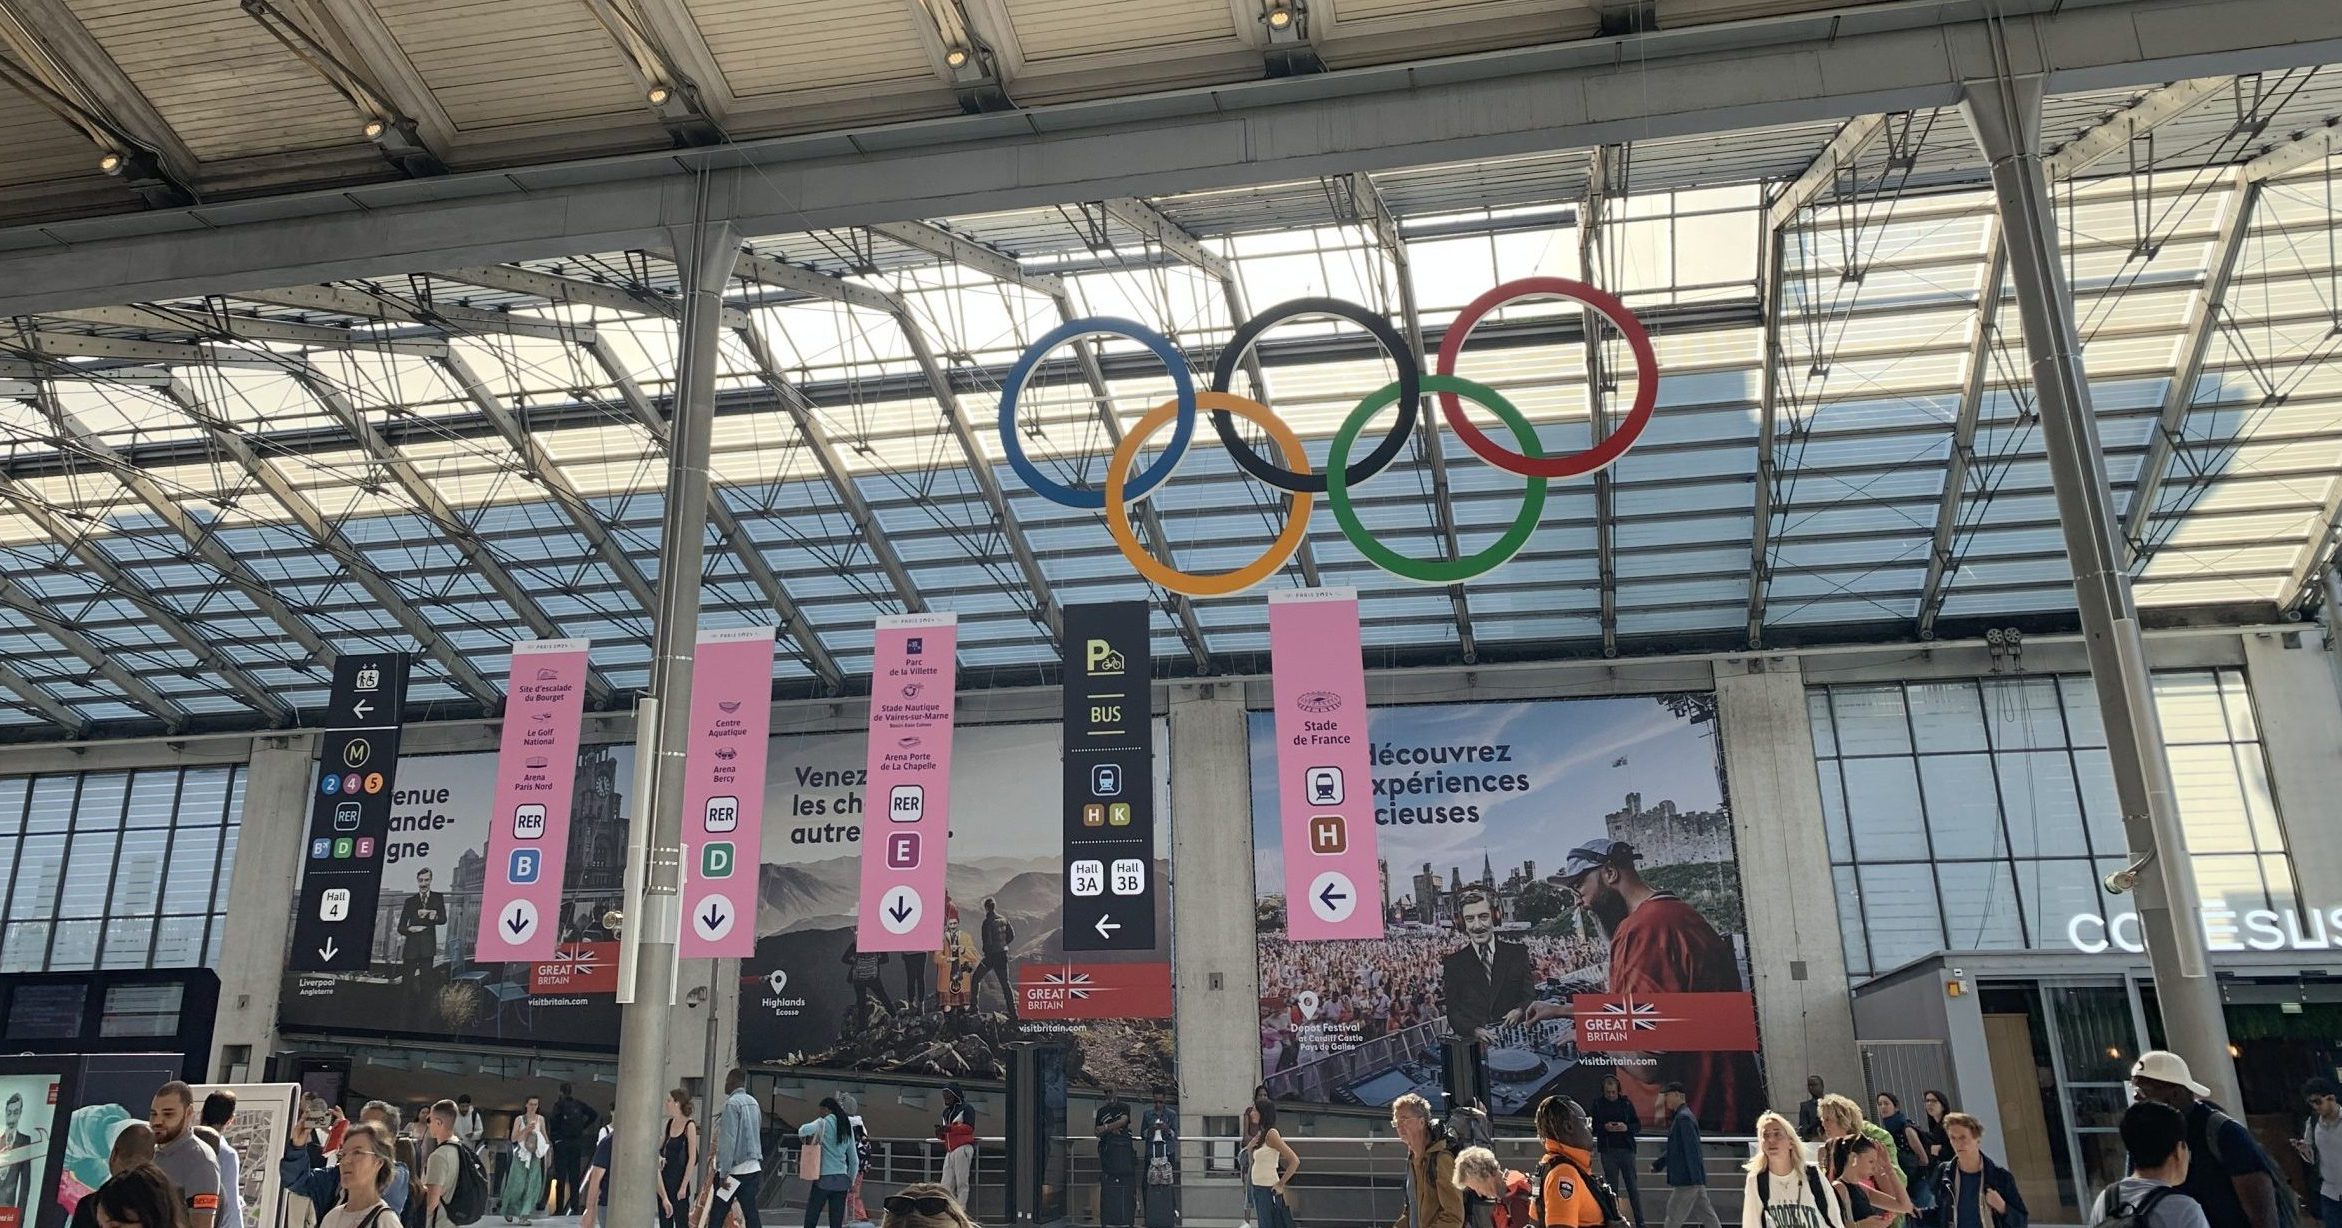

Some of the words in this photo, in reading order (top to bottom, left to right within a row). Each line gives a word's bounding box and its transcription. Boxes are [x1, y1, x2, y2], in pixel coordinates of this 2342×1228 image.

[901, 668, 908, 676] la
[910, 667, 938, 675] Villette
[519, 685, 534, 693] Site
[535, 684, 572, 693] d'escalade
[536, 694, 564, 703] Bourget
[881, 704, 903, 712] Stade
[905, 703, 940, 713] Nautique
[885, 712, 949, 721] Vaires-sur-Marne
[1091, 705, 1121, 723] BUS
[716, 719, 741, 728] Centre
[1304, 719, 1338, 732] Stade
[538, 728, 554, 737] Golf
[708, 727, 748, 738] Aquatique
[524, 737, 555, 746] National
[1293, 734, 1308, 746] de
[1312, 733, 1351, 745] France
[350, 745, 364, 761] M
[884, 753, 908, 761] Arena
[910, 752, 931, 761] Porte
[713, 765, 736, 774] Arena
[880, 762, 891, 771] de
[892, 762, 902, 771] La
[903, 761, 937, 772] Chapelle
[524, 774, 546, 782] Arena
[713, 774, 736, 784] Bercy
[795, 766, 868, 788] Venez
[327, 778, 335, 791] 2
[347, 777, 356, 790] 4
[370, 777, 378, 790] 5
[515, 783, 532, 791] Paris
[534, 782, 553, 790] Nord
[793, 794, 826, 816] les
[894, 796, 919, 811] RER
[338, 810, 358, 823] RER
[709, 807, 734, 822] RER
[1089, 809, 1100, 822] H
[1115, 808, 1126, 820] K
[518, 814, 542, 829] RER
[1318, 824, 1338, 846] H
[339, 842, 349, 854] D
[360, 842, 370, 854] E
[897, 840, 910, 861] E
[710, 850, 728, 871] D
[516, 857, 532, 876] B
[1077, 863, 1099, 874] Hall
[1117, 862, 1139, 874] Hall
[1077, 876, 1098, 892] 3A
[1117, 876, 1139, 891] 3B
[327, 892, 346, 902] Hall
[330, 904, 338, 918] 4
[538, 964, 572, 976] GREAT
[299, 978, 336, 989] Liverpool
[538, 975, 570, 985] BRITAIN
[300, 988, 334, 998] Angleterre
[1027, 988, 1065, 1000] GREAT
[528, 996, 588, 1007] visitbritain.com
[762, 998, 806, 1008] Highlands
[1028, 1000, 1064, 1010] BRITAIN
[776, 1008, 800, 1016] Ecosse
[1018, 1024, 1088, 1034] visitbritain.com
[1290, 1024, 1321, 1034] Depot
[1323, 1022, 1360, 1032] Festival
[1584, 1018, 1628, 1032] GREAT
[1308, 1034, 1337, 1042] Cardiff
[1338, 1034, 1364, 1042] Castle
[1587, 1031, 1628, 1042] BRITAIN
[1300, 1044, 1318, 1052] Pays
[1320, 1043, 1330, 1051] de
[1331, 1042, 1356, 1051] Galles
[1578, 1056, 1658, 1067] visitbritain.com
